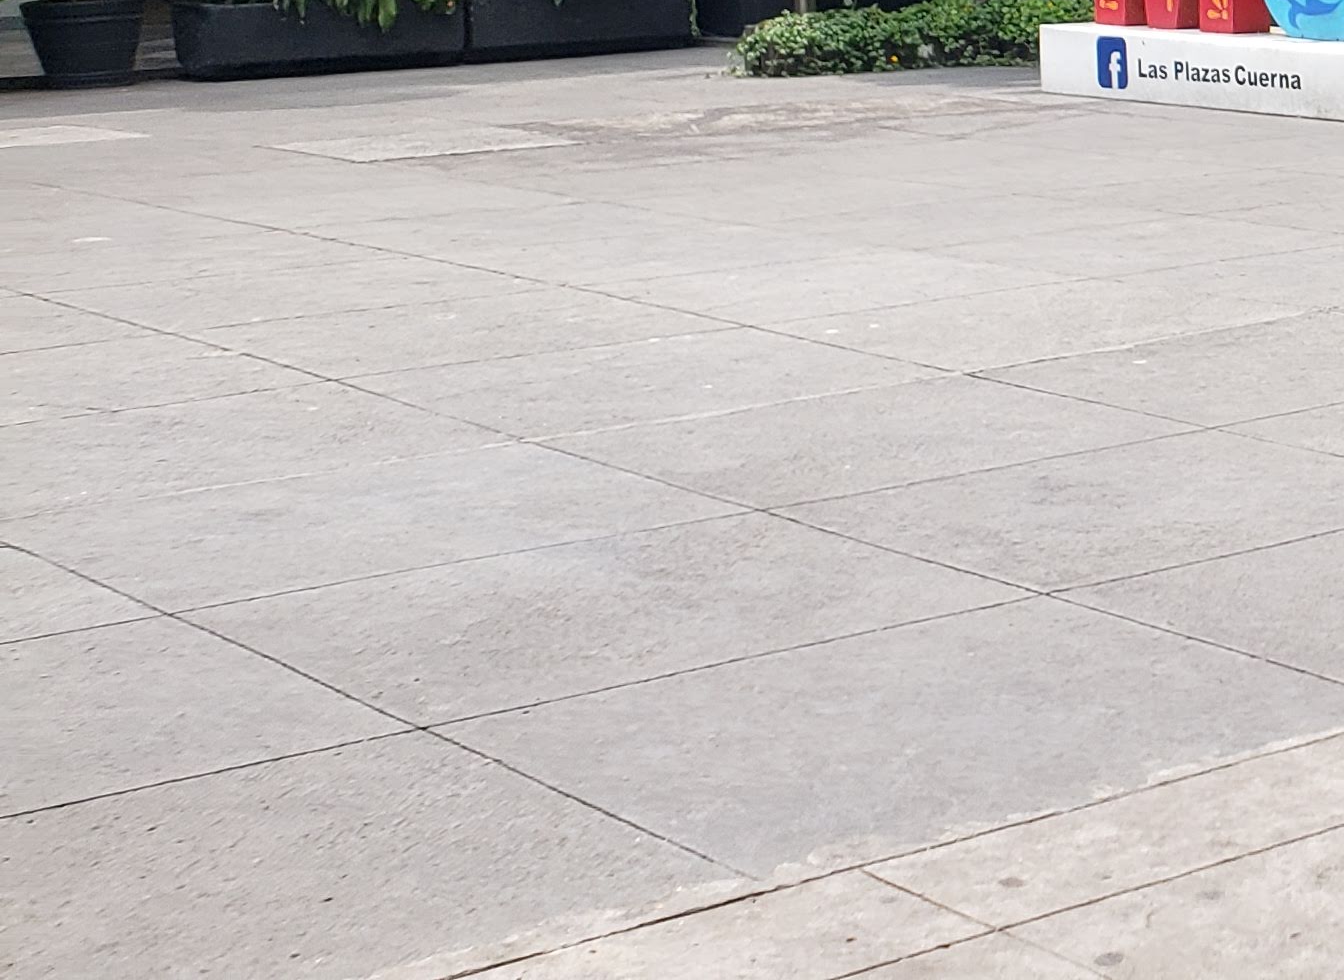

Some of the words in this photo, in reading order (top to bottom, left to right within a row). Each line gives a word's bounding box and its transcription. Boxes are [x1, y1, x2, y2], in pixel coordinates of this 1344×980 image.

[1138, 58, 1168, 80] Las
[1173, 60, 1231, 84] Plazas
[1234, 64, 1302, 90] Cuerna
